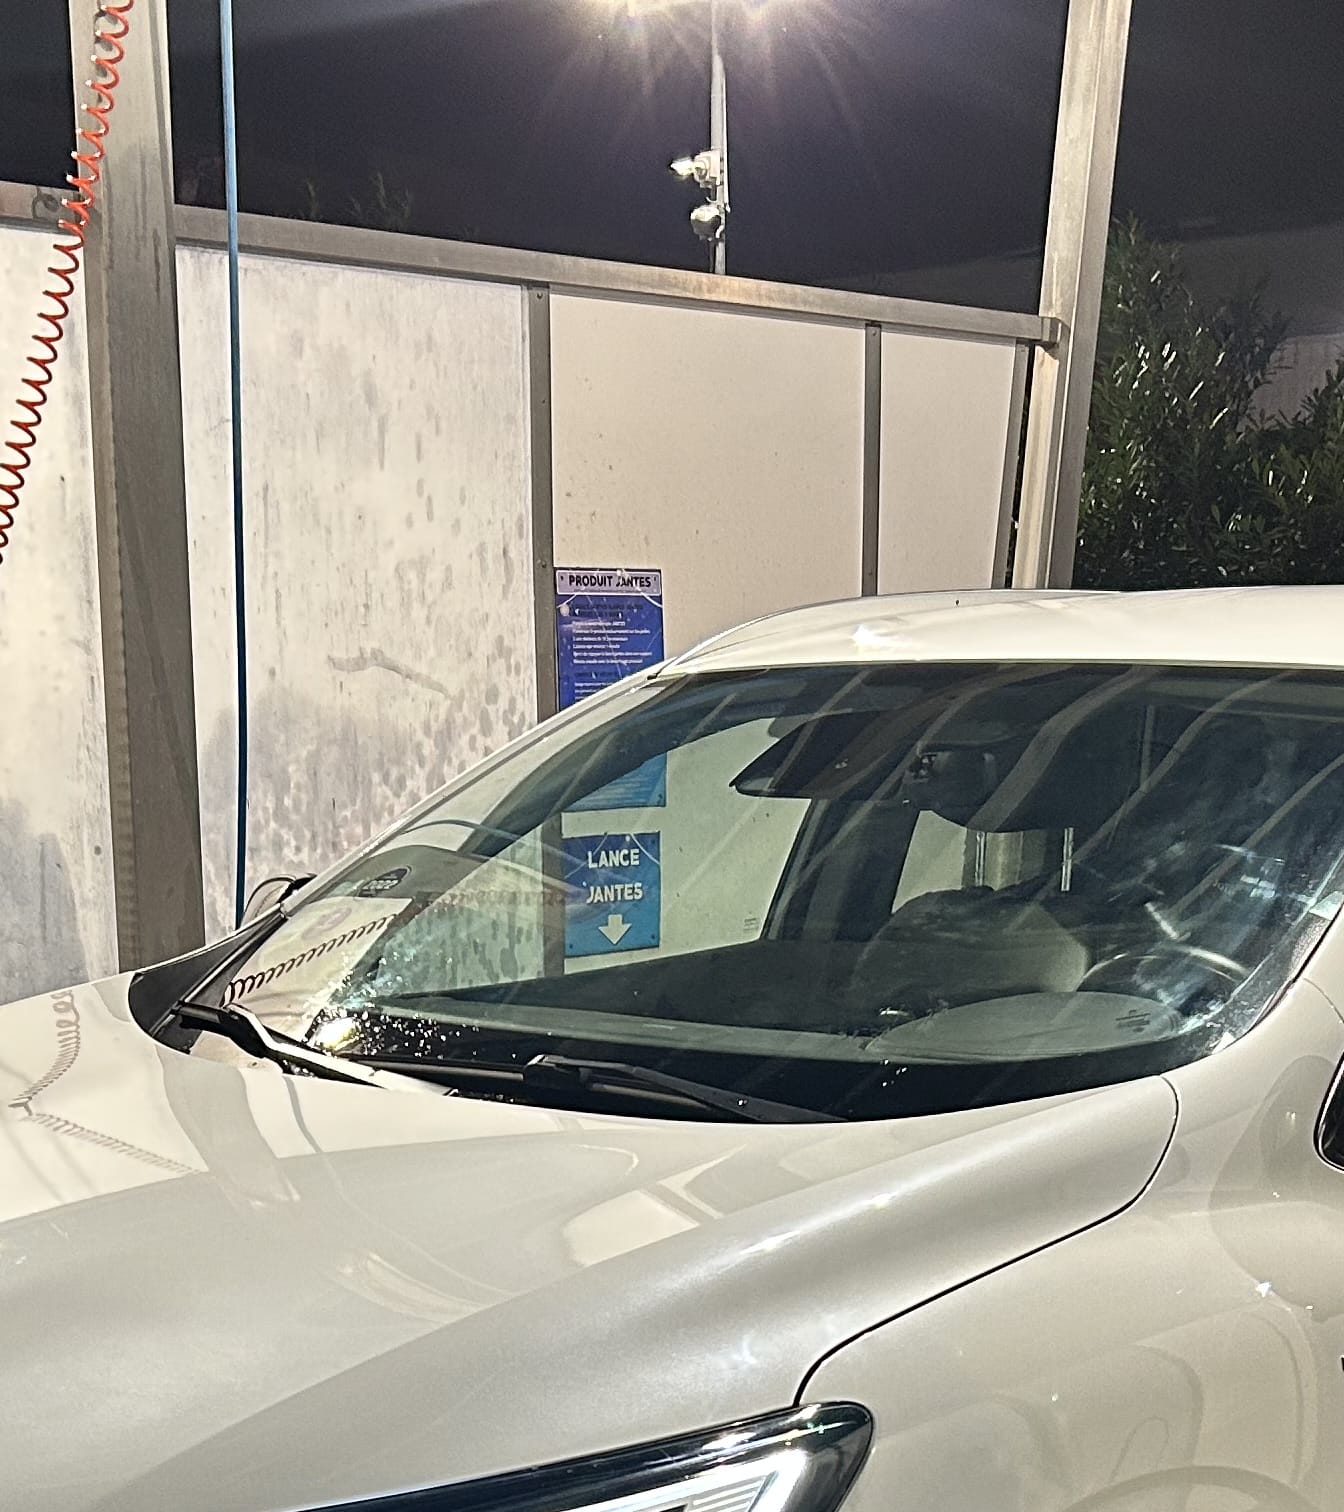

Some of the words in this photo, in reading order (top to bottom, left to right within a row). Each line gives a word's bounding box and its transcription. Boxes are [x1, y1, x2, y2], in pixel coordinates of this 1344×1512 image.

[568, 575, 613, 587] PRODUIT
[616, 576, 651, 588] JANTES
[587, 848, 640, 869] LANCE
[586, 882, 643, 904] JANTES
